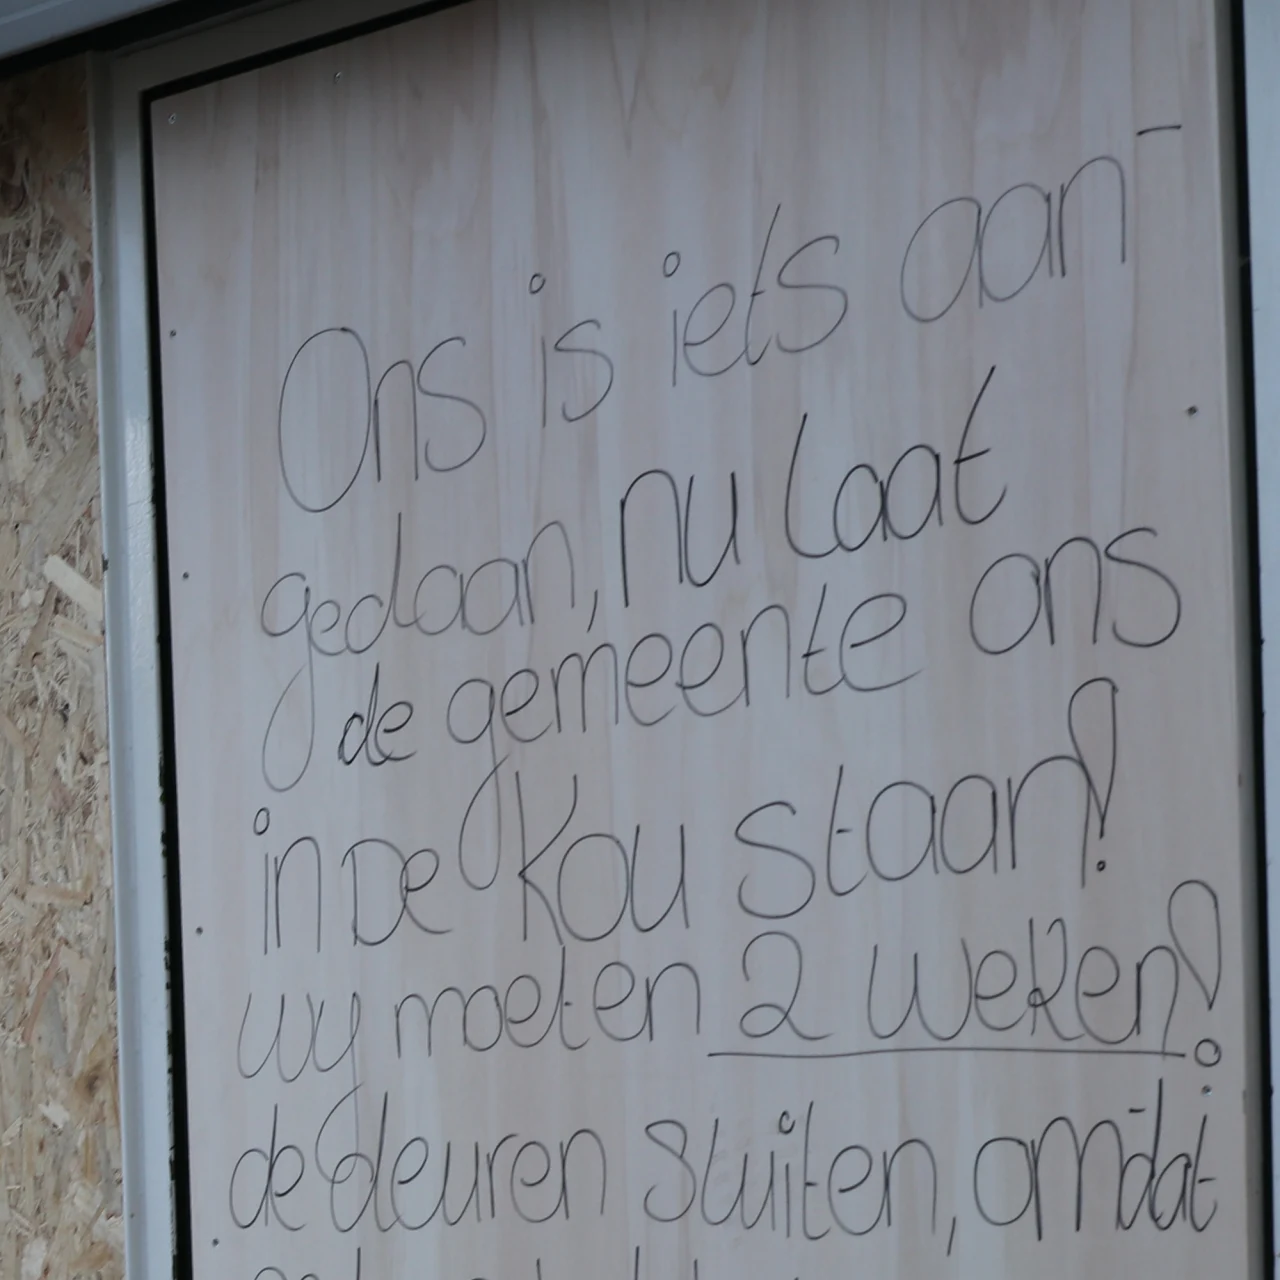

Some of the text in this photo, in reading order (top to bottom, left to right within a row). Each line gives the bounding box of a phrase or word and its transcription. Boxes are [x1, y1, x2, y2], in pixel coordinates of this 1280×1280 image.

[278, 325, 487, 514] Ons
[528, 272, 615, 430] is
[661, 203, 850, 388] iets
[618, 467, 742, 611] nu
[784, 364, 1007, 562] laat
[338, 662, 418, 767] de
[446, 582, 924, 893] gemeente
[252, 806, 322, 956] in
[393, 944, 706, 1063] moeten
[739, 930, 836, 1041] 2
[229, 1103, 307, 1231] de
[330, 1091, 609, 1233] deuren
